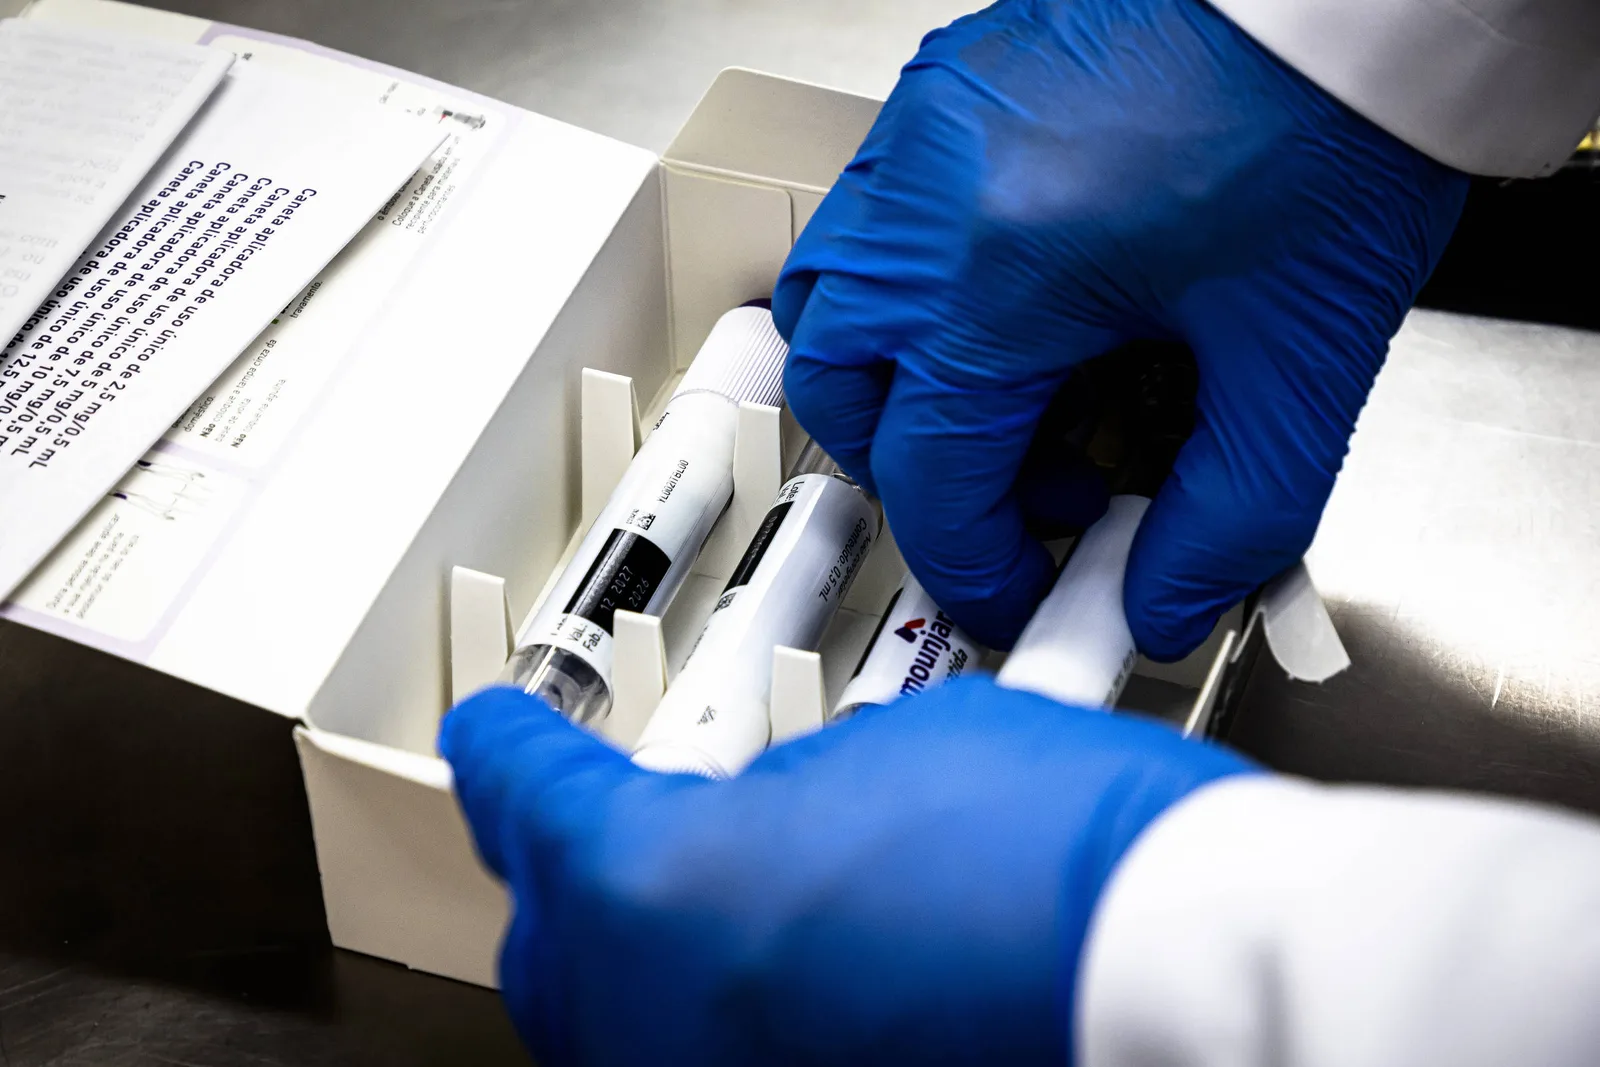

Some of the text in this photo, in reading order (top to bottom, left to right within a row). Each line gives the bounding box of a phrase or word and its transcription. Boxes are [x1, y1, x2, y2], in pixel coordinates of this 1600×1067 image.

[157, 160, 203, 197] Caneta
[184, 162, 230, 198] Caneta
[202, 173, 248, 209] Caneta
[226, 177, 271, 213] Caneta
[392, 200, 415, 226] Coloque
[414, 175, 434, 195] Caneta
[95, 199, 160, 257] aplicadora
[123, 200, 187, 258] aplicadora
[140, 211, 205, 270] aplicadora
[164, 215, 229, 274] aplicadora
[78, 260, 99, 274] de
[107, 261, 126, 275] de
[124, 273, 144, 286] de
[55, 276, 82, 298] uso
[84, 278, 110, 298] uso
[101, 289, 127, 309] uso
[148, 277, 168, 290] de
[21, 300, 61, 330] único
[49, 301, 88, 332] único
[125, 293, 151, 313] uso
[10, 188, 289, 454] Caneta aplicadora de uso único de 5 mg/0,5 mL
[28, 188, 316, 467] Caneta aplicadora de uso único de 2,5 mg/0,5 mL
[66, 312, 105, 343] único
[91, 316, 130, 347] único
[31, 334, 51, 349] de
[48, 346, 68, 360] de
[73, 350, 93, 364] de
[3, 354, 36, 378] 12,5
[31, 365, 53, 378] 10
[52, 368, 80, 387] 7,5
[200, 423, 216, 437] Não
[253, 348, 270, 366] cinza
[265, 338, 277, 348] da
[6, 388, 54, 433] mg/0,5
[231, 434, 246, 447] Não
[818, 517, 868, 602] Conteúdo: 0,5 mL
[600, 597, 615, 611] 12
[610, 564, 633, 594] 2027
[899, 610, 956, 698] mounjar
